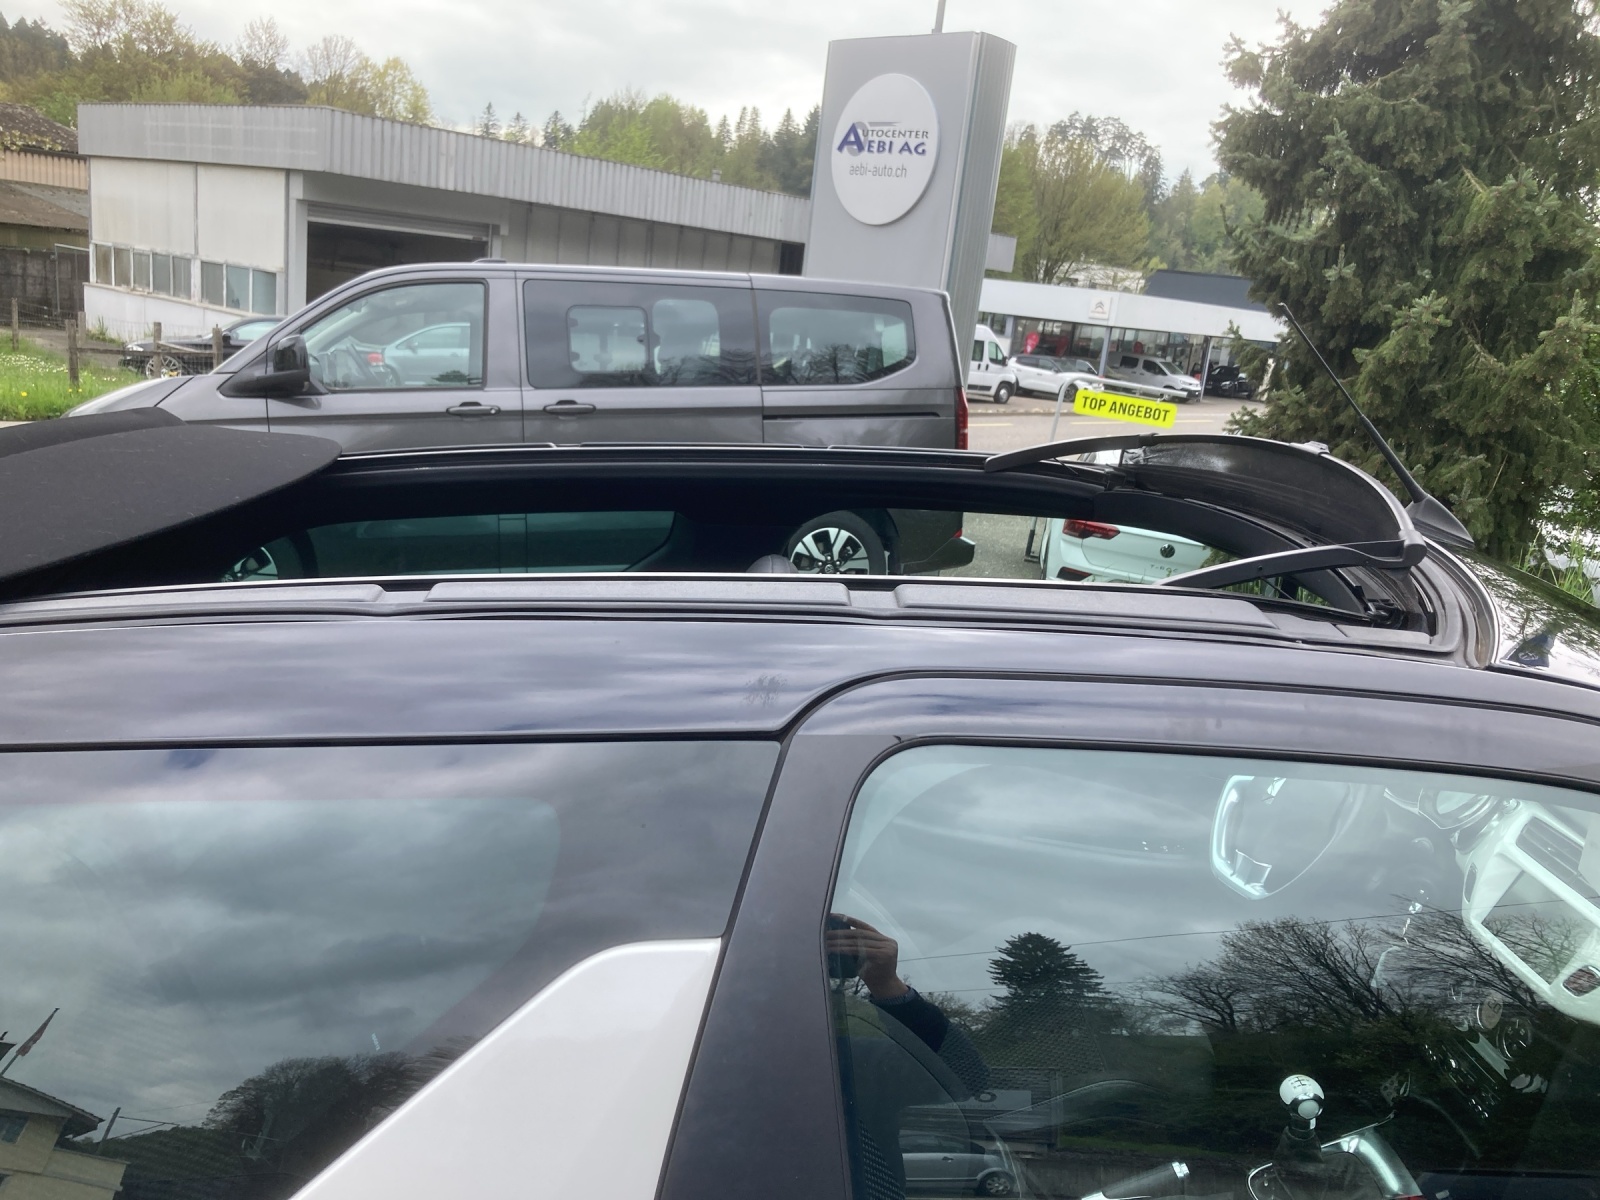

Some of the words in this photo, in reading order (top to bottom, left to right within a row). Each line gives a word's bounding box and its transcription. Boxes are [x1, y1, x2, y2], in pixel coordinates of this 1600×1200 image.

[898, 141, 926, 156] AG
[849, 162, 907, 178] aebi-auto.ch
[1082, 396, 1106, 411] TOP
[1108, 401, 1170, 422] ANGEBOT
